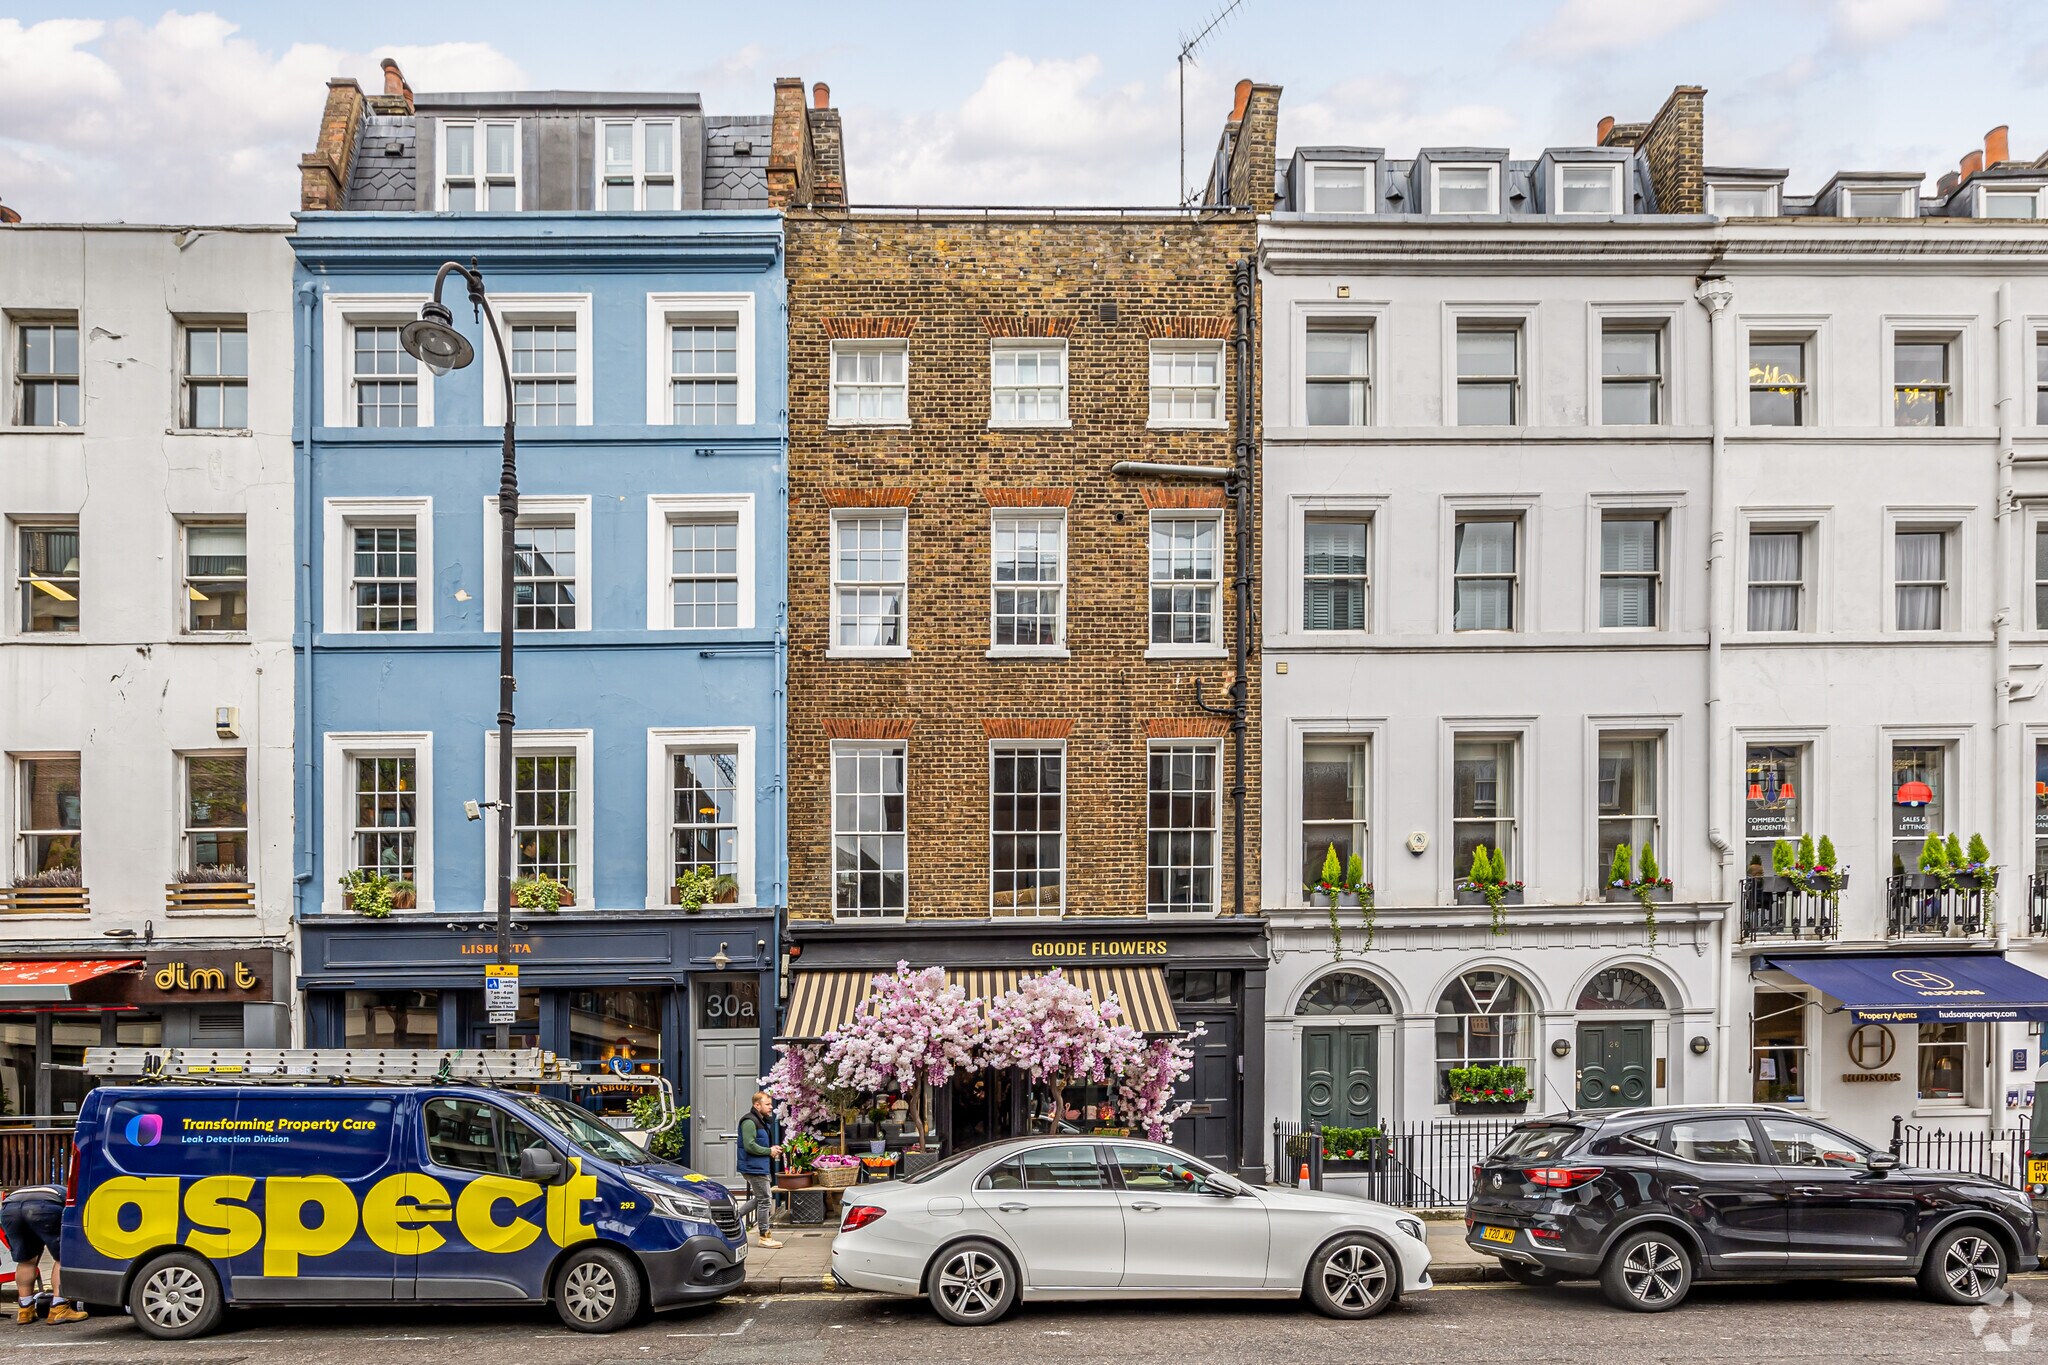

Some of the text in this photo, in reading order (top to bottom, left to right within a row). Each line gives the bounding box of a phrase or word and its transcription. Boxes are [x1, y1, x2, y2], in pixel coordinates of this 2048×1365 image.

[461, 944, 532, 954] LISBTA
[1032, 941, 1167, 956] GOODE FLOWERS
[154, 961, 256, 990] dim t
[707, 994, 754, 1016] 30a
[1859, 1012, 1918, 1020] Property Agents
[1939, 1010, 2017, 1019] hudsonsproperty.com
[1843, 1073, 1901, 1082] HUDSONS
[591, 1084, 644, 1096] LISBOETA
[182, 1118, 376, 1132] Transforming Property Care
[82, 1156, 599, 1278] aspect
[1484, 1228, 1500, 1239] LT20
